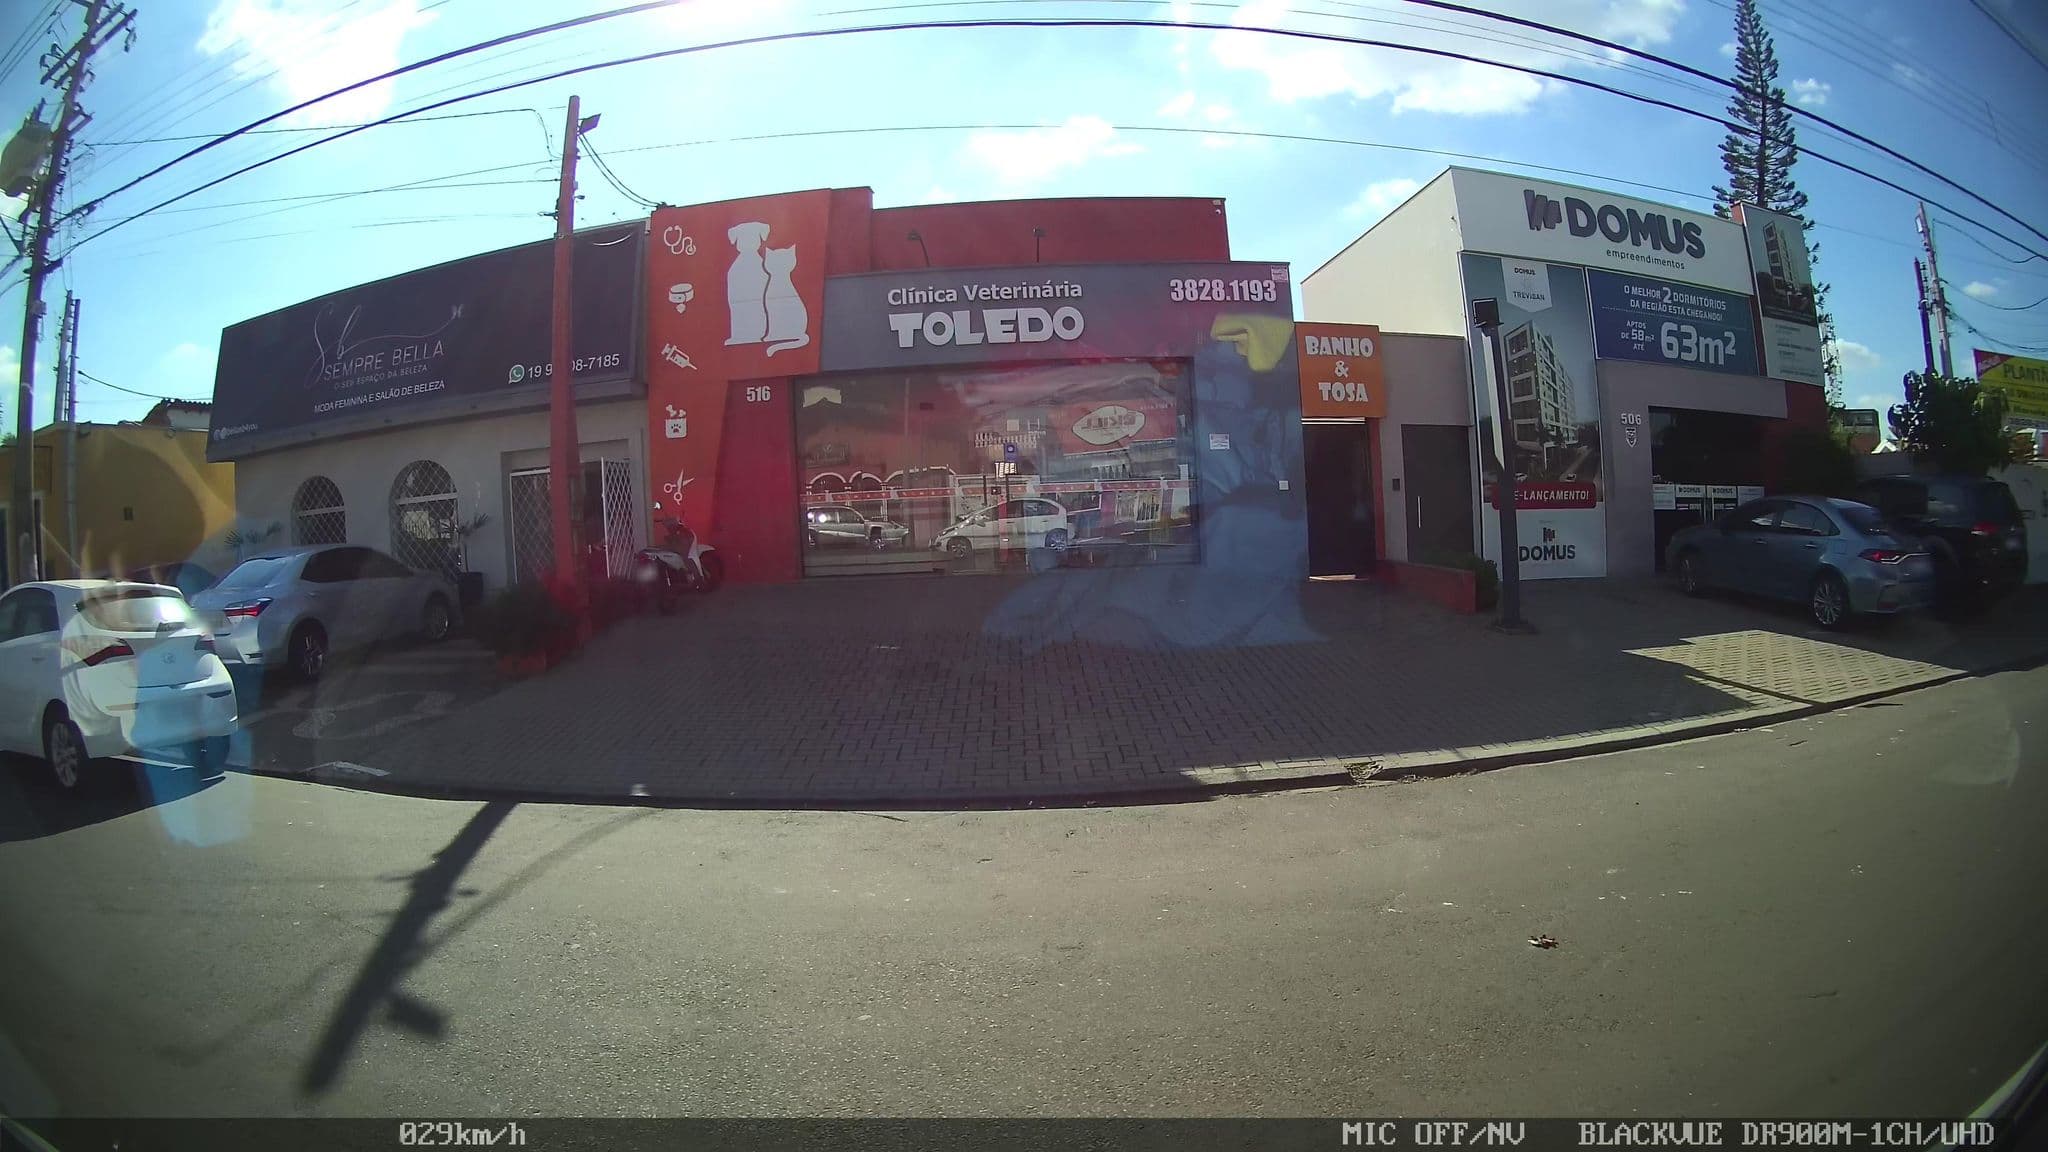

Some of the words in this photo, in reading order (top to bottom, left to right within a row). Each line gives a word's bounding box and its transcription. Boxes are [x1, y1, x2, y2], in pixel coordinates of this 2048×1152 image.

[1564, 196, 1706, 259] DOMUS
[1606, 249, 1686, 270] empreendimentos
[887, 286, 958, 306] Clínica
[963, 280, 1084, 301] Veterinária
[1169, 279, 1277, 302] 3828.1193
[1624, 285, 1630, 294] O
[1631, 287, 1661, 299] MELHOR
[1662, 287, 1672, 304] 2
[1673, 292, 1727, 311] DORMITÓRIOS
[1630, 299, 1641, 309] DA
[1642, 300, 1668, 313] REGIÃO
[888, 306, 1085, 348] TOLEDO
[1626, 320, 1647, 330] APTOS
[1621, 332, 1630, 340] DE
[1305, 335, 1374, 358] BANHO
[323, 352, 385, 381] SEMPRE
[392, 340, 444, 366] BELLA
[1334, 360, 1349, 378] &
[527, 365, 542, 379] 19
[314, 401, 335, 413] MODA
[335, 393, 369, 410] FEMININA
[375, 386, 400, 401] SALÃO
[401, 384, 414, 396] DE
[414, 380, 445, 393] BELEZA
[746, 386, 772, 402] 516
[1318, 382, 1369, 402] TOSA
[1621, 413, 1642, 425] 506
[1519, 545, 1577, 562] DOMUS
